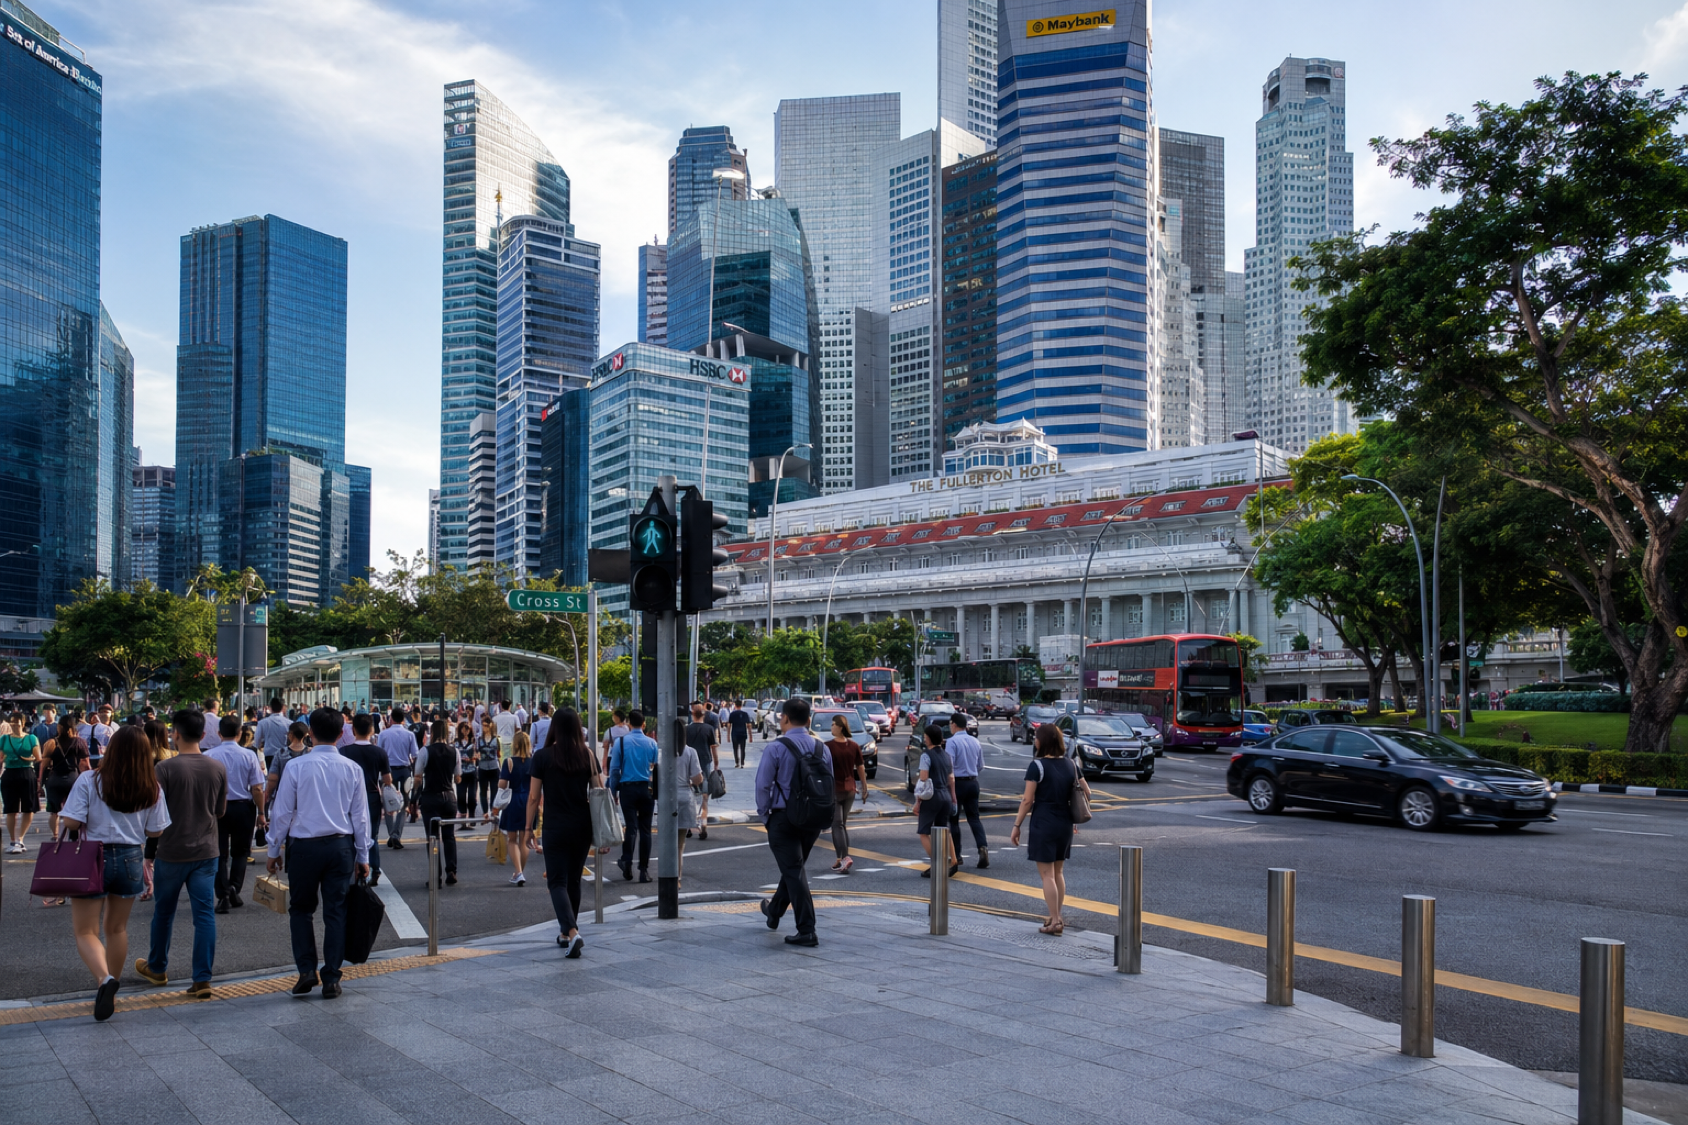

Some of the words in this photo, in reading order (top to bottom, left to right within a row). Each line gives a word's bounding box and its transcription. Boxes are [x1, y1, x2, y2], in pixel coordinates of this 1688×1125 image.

[1048, 13, 1110, 31] Maybank
[689, 358, 726, 380] HSBC
[910, 480, 934, 493] THE
[940, 468, 1013, 489] FULLERTON
[1019, 462, 1066, 478] HOTEL
[517, 593, 560, 608] Cross
[566, 595, 581, 609] St
